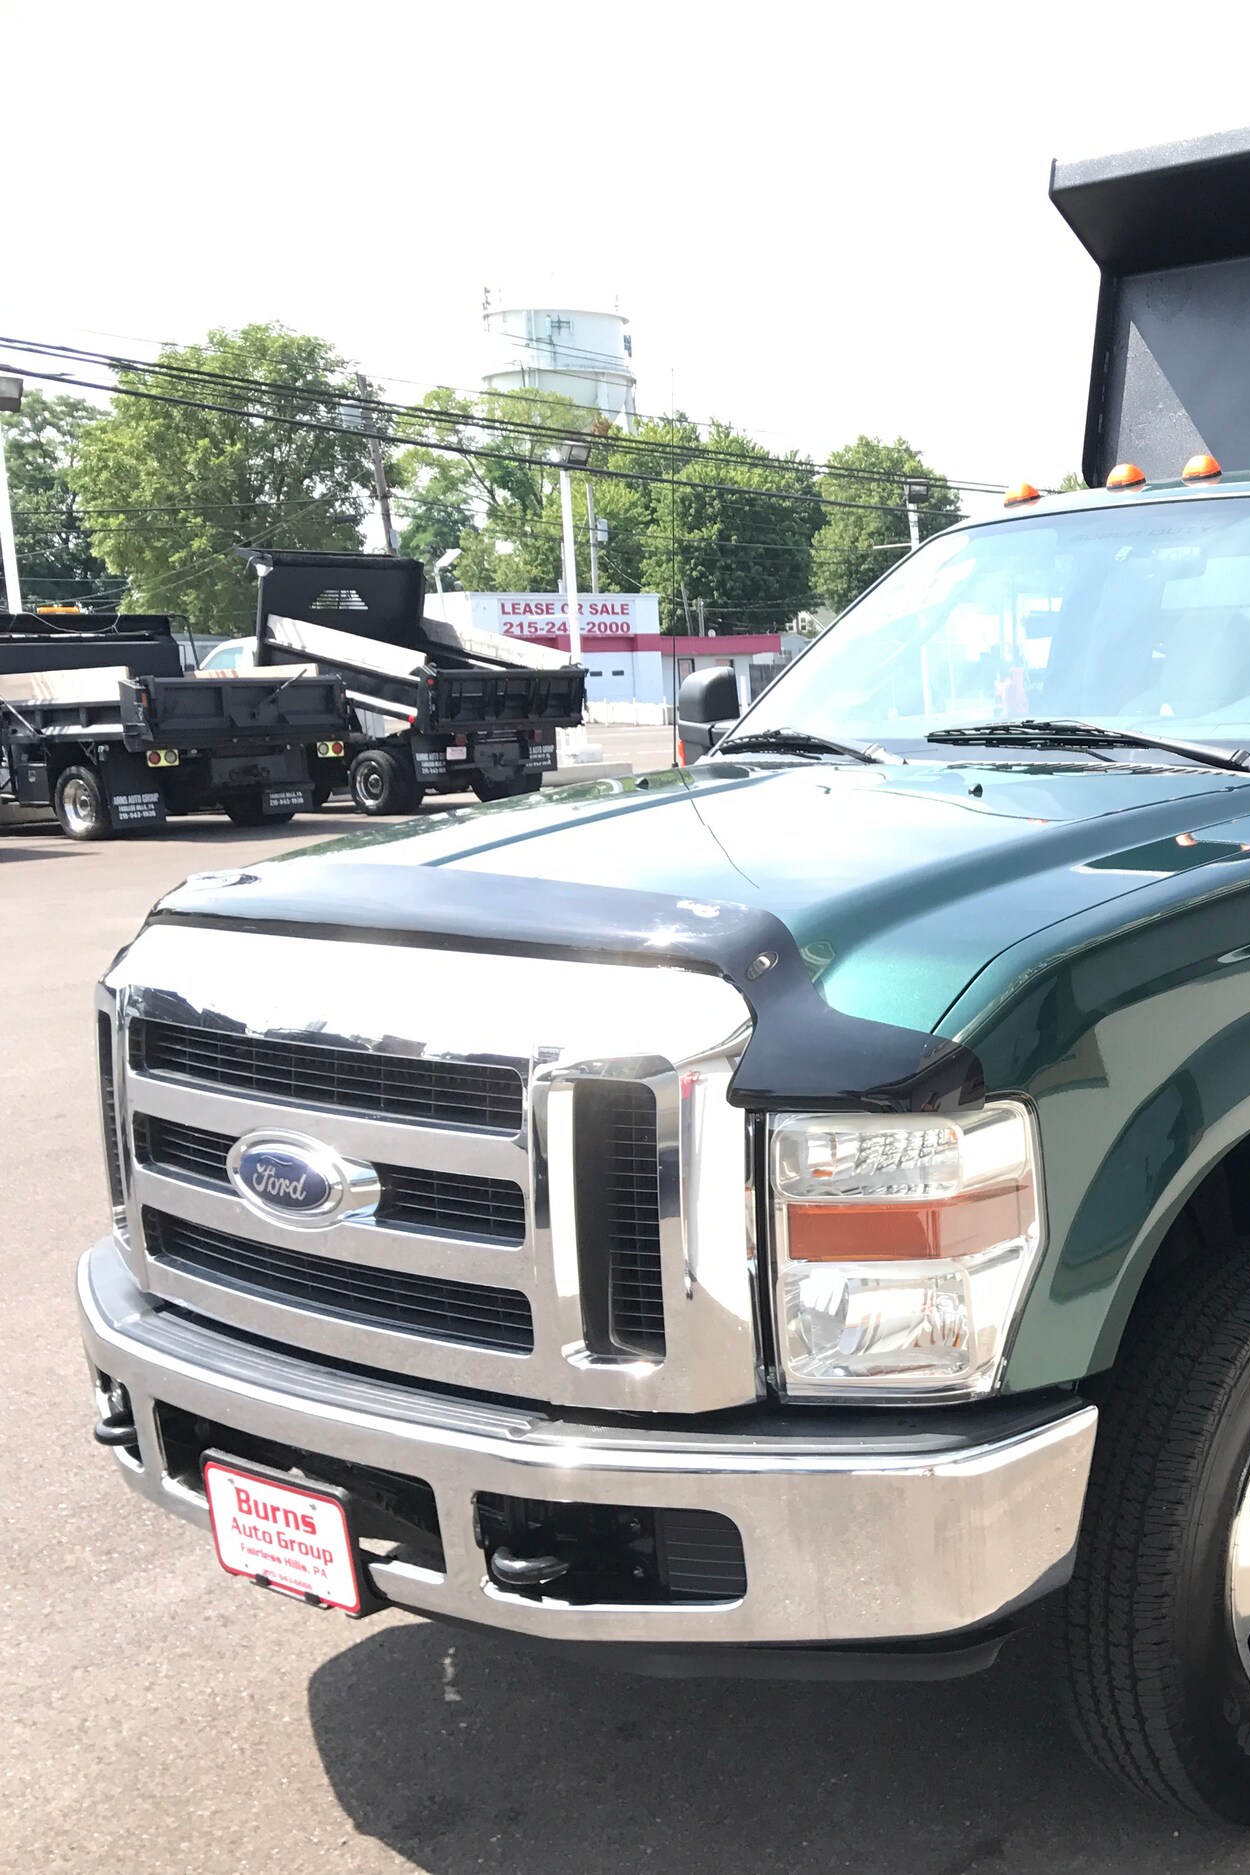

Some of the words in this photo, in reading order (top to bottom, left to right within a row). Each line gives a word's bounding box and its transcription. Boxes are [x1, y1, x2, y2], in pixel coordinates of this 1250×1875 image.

[501, 602, 555, 615] LEASE
[589, 603, 629, 615] SALE
[503, 621, 631, 634] 215-24-2000
[253, 1163, 307, 1200] Ford
[235, 1486, 317, 1535] Burns
[231, 1517, 273, 1545] Auto
[276, 1531, 333, 1566] Group
[240, 1543, 282, 1564] Fairless
[313, 1566, 328, 1579] PA
